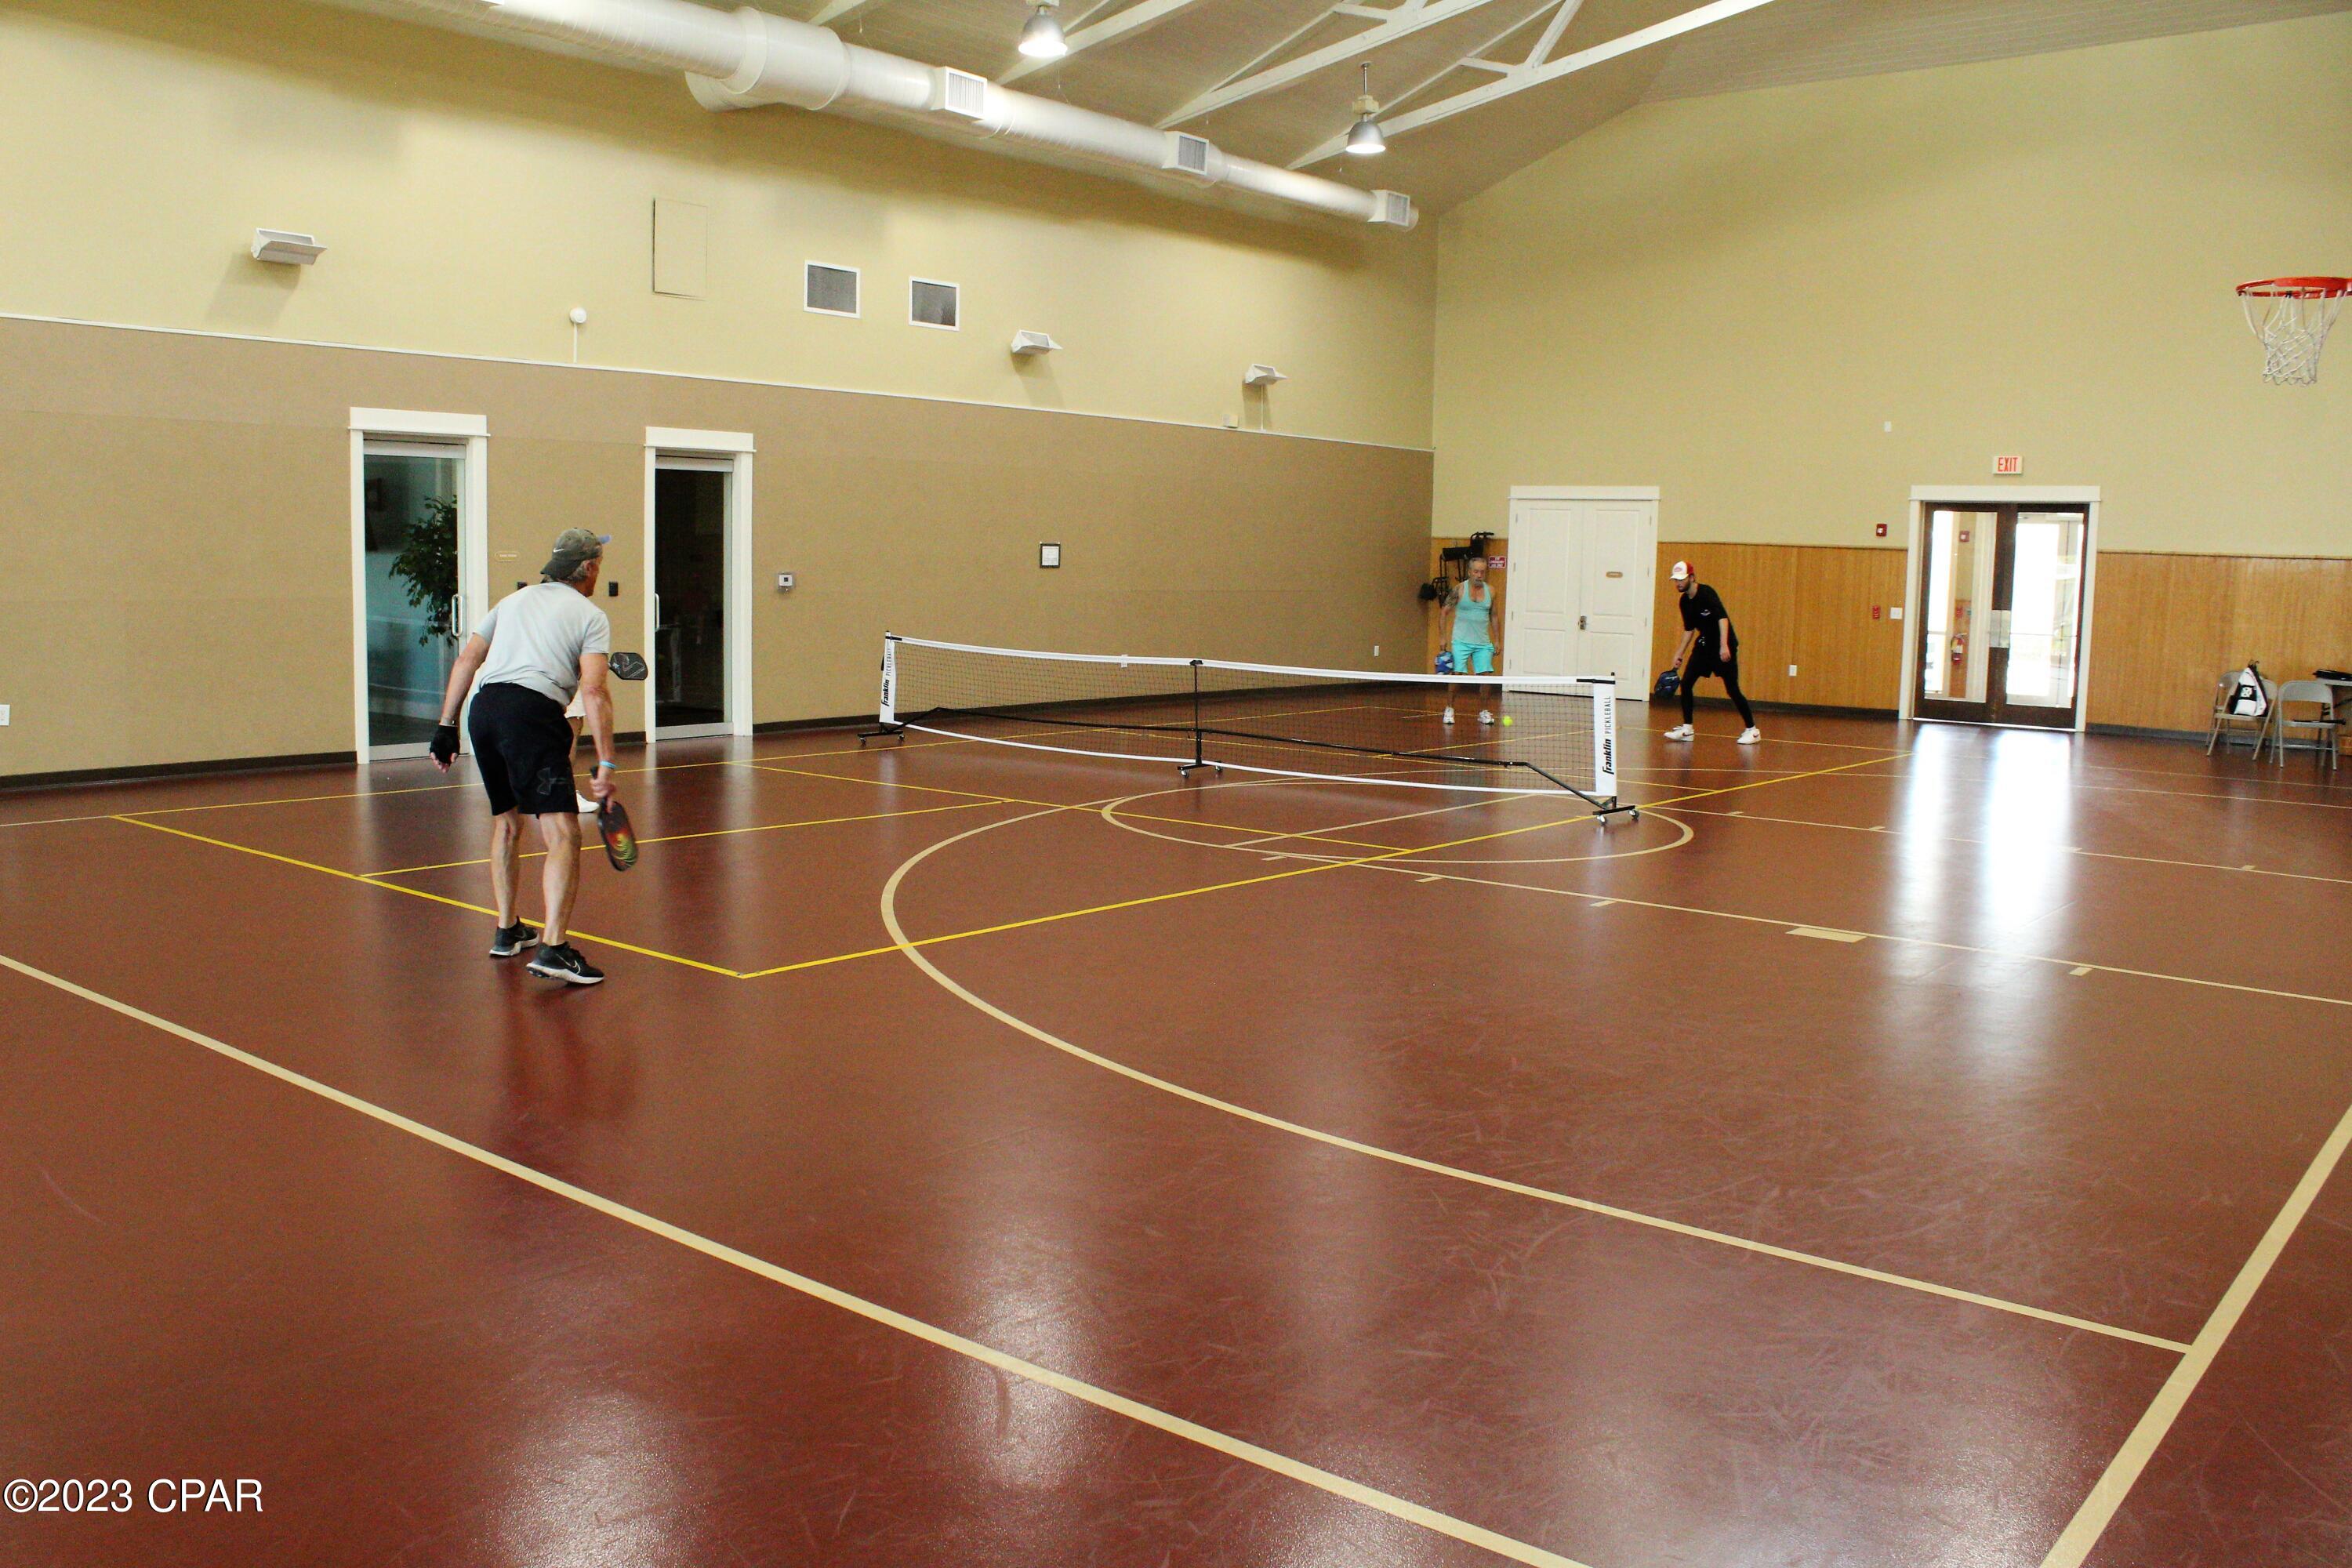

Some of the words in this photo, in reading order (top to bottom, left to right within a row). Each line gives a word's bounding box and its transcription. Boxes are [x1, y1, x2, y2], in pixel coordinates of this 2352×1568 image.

[1998, 457, 2018, 472] EXIT
[881, 679, 890, 707] franklin
[1602, 739, 1614, 775] franklin
